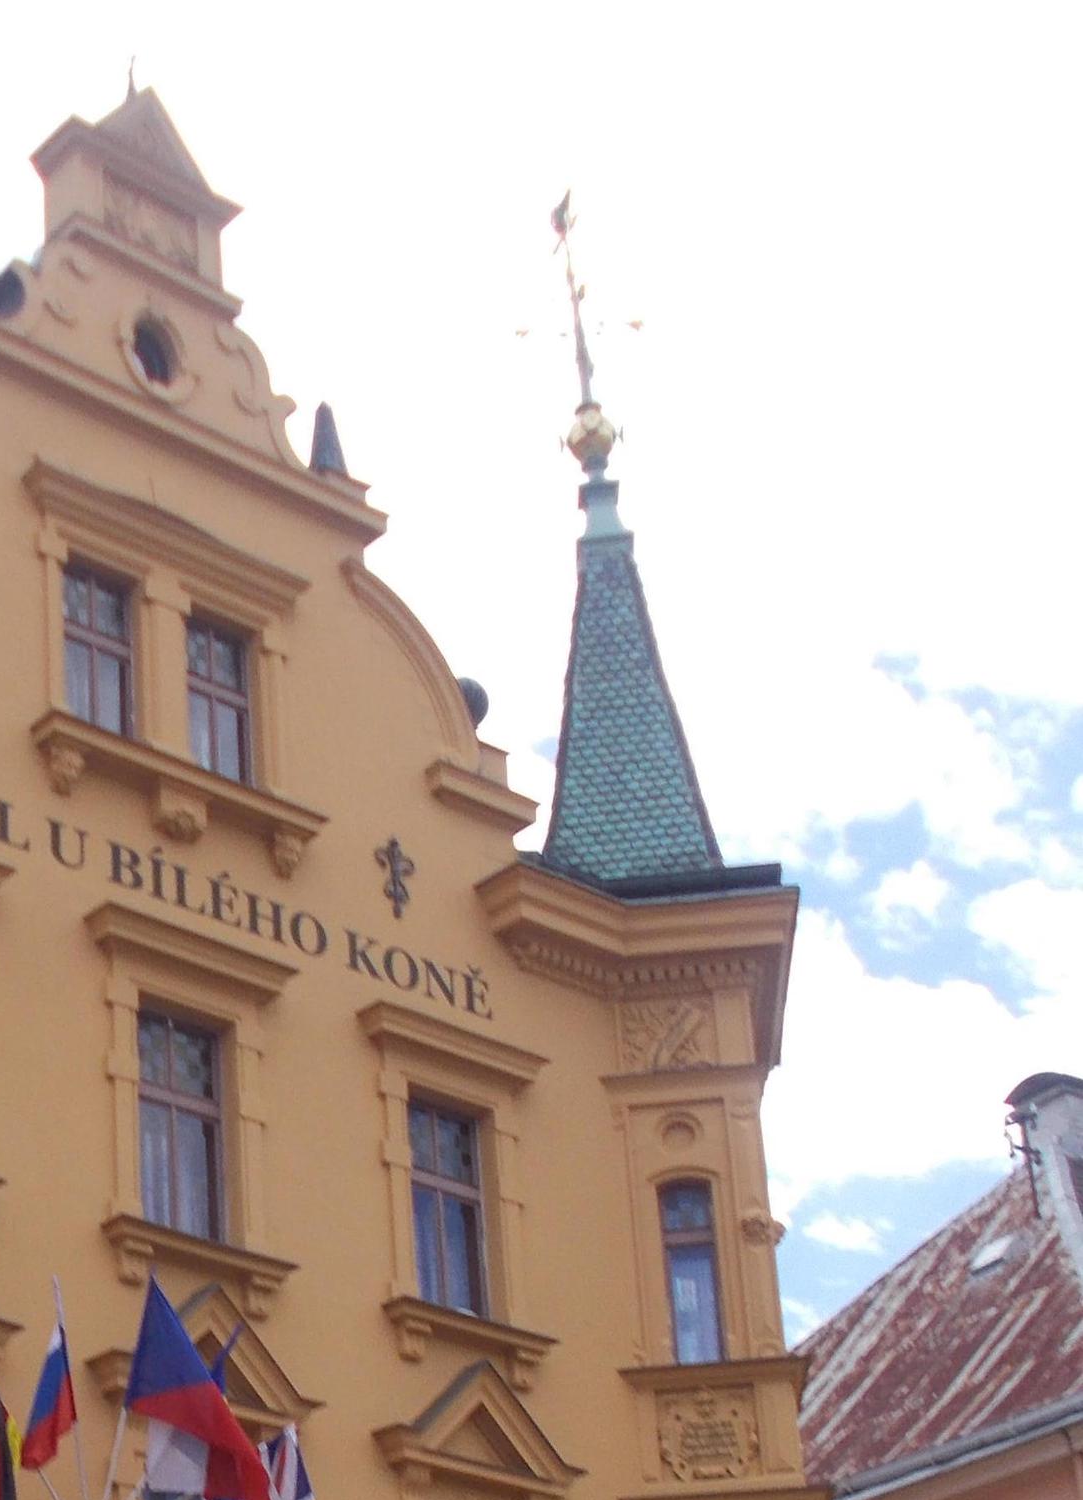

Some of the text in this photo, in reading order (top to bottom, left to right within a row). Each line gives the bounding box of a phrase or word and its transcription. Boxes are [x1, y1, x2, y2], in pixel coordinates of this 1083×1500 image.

[47, 818, 89, 869] U
[106, 840, 329, 957] BÍLÉHO
[344, 929, 494, 1020] KONĚ
